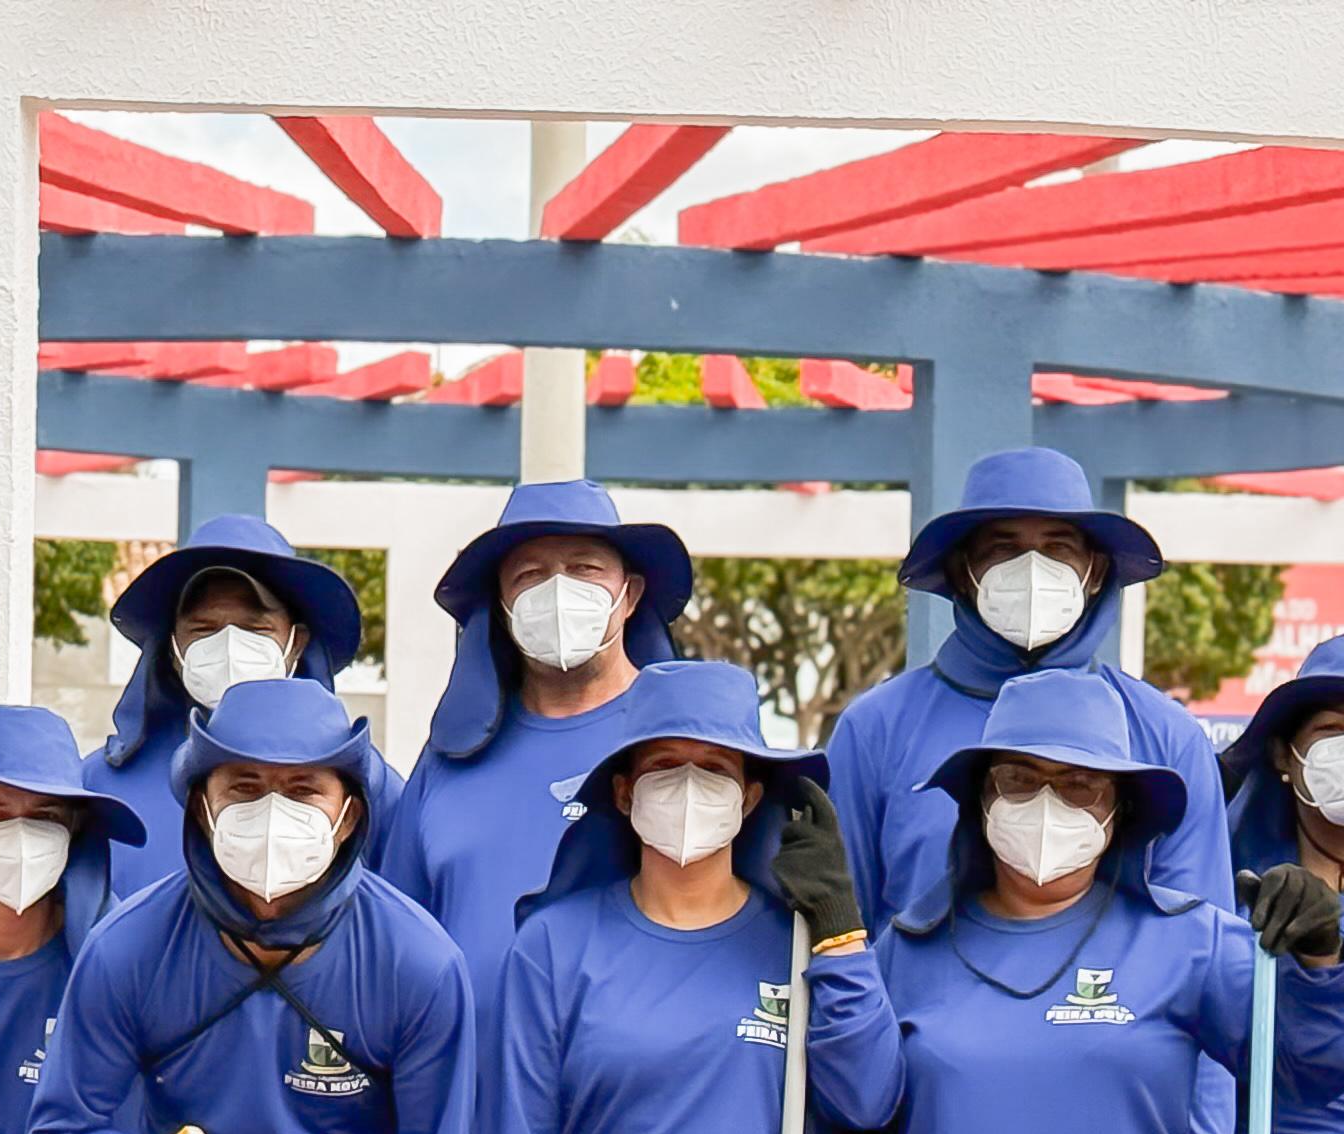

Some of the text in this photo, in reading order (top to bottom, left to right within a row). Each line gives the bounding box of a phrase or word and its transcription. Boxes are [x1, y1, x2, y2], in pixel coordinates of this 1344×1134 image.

[1046, 1009, 1135, 1021] FEIRA NOVA
[737, 1025, 778, 1041] FEIRA
[284, 1074, 327, 1091] FEIRA
[330, 1078, 370, 1091] NOVA
